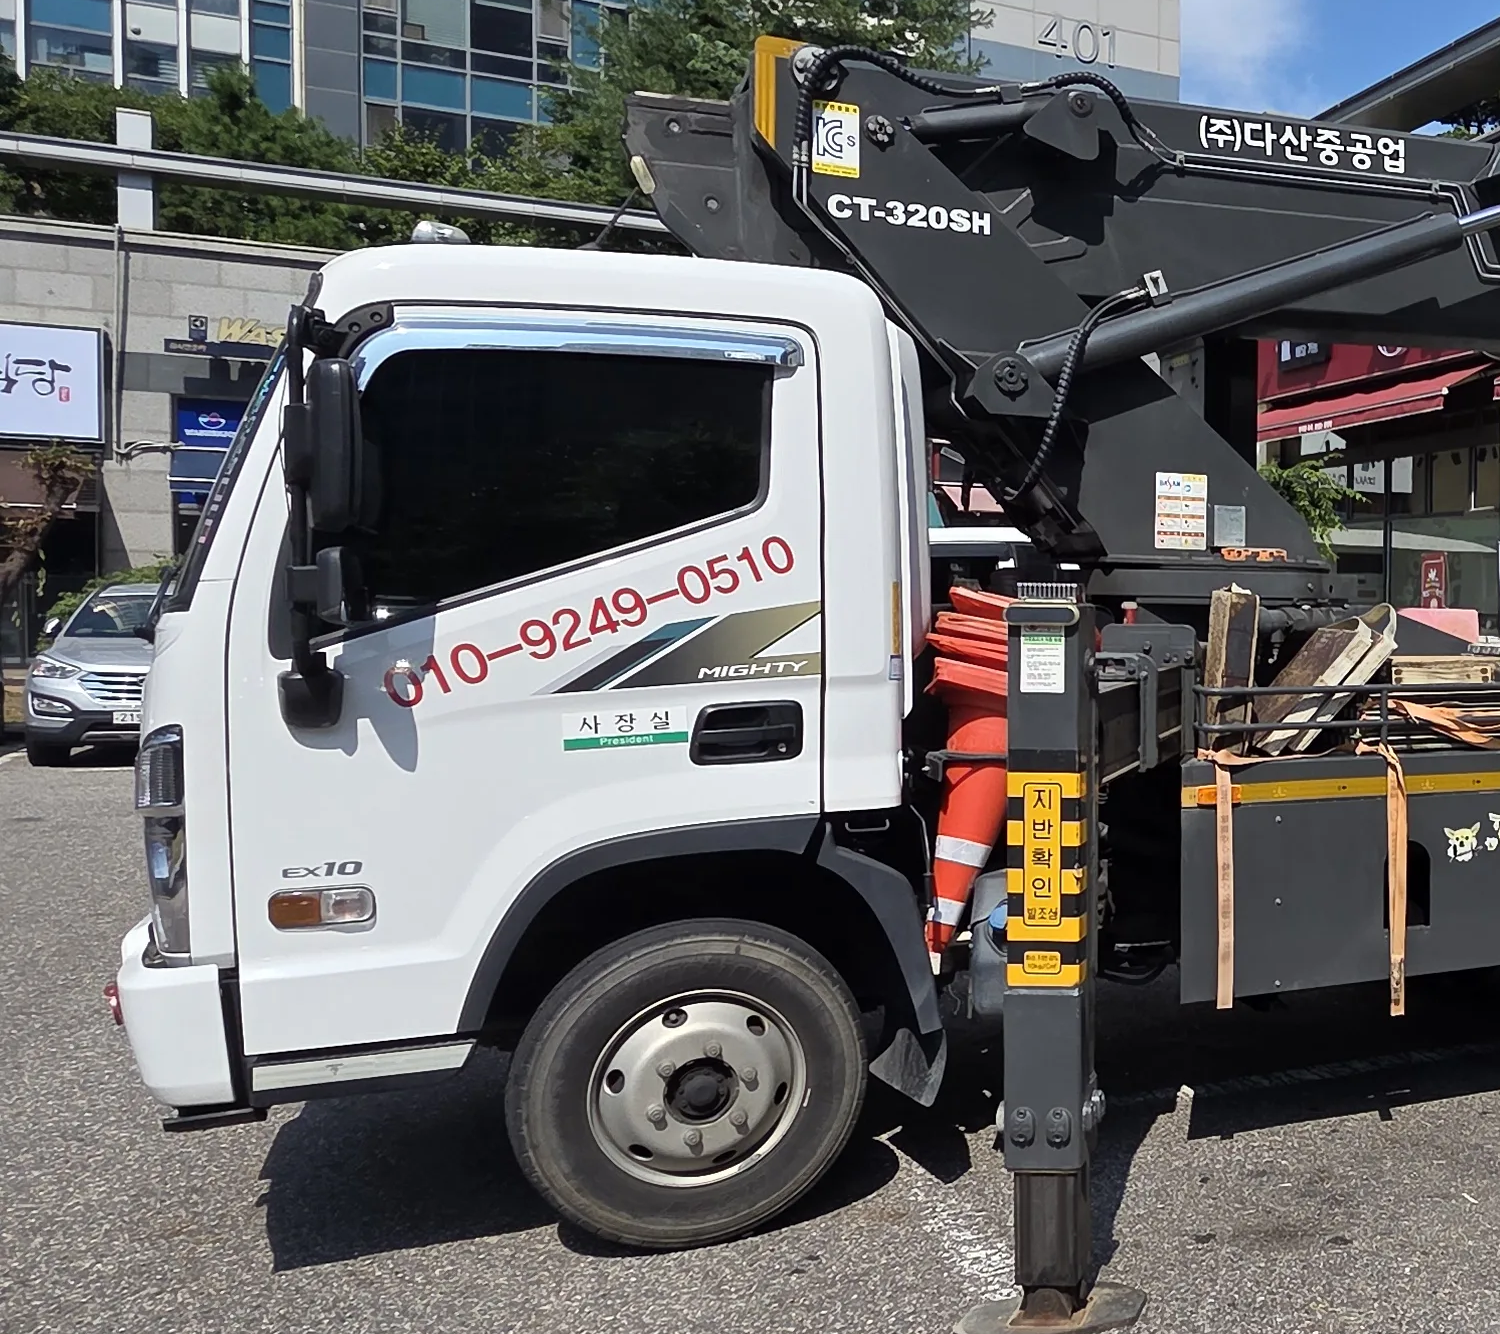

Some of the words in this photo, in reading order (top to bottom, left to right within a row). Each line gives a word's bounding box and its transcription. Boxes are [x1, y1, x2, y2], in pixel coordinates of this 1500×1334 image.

[1038, 12, 1117, 68] 401
[1199, 114, 1406, 173] (주)다산중공업
[827, 193, 991, 235] CT-320SH
[383, 536, 795, 708] 010-9249-0510
[697, 660, 809, 680] MIGHTY
[599, 734, 654, 746] President
[281, 860, 363, 879] EX10
